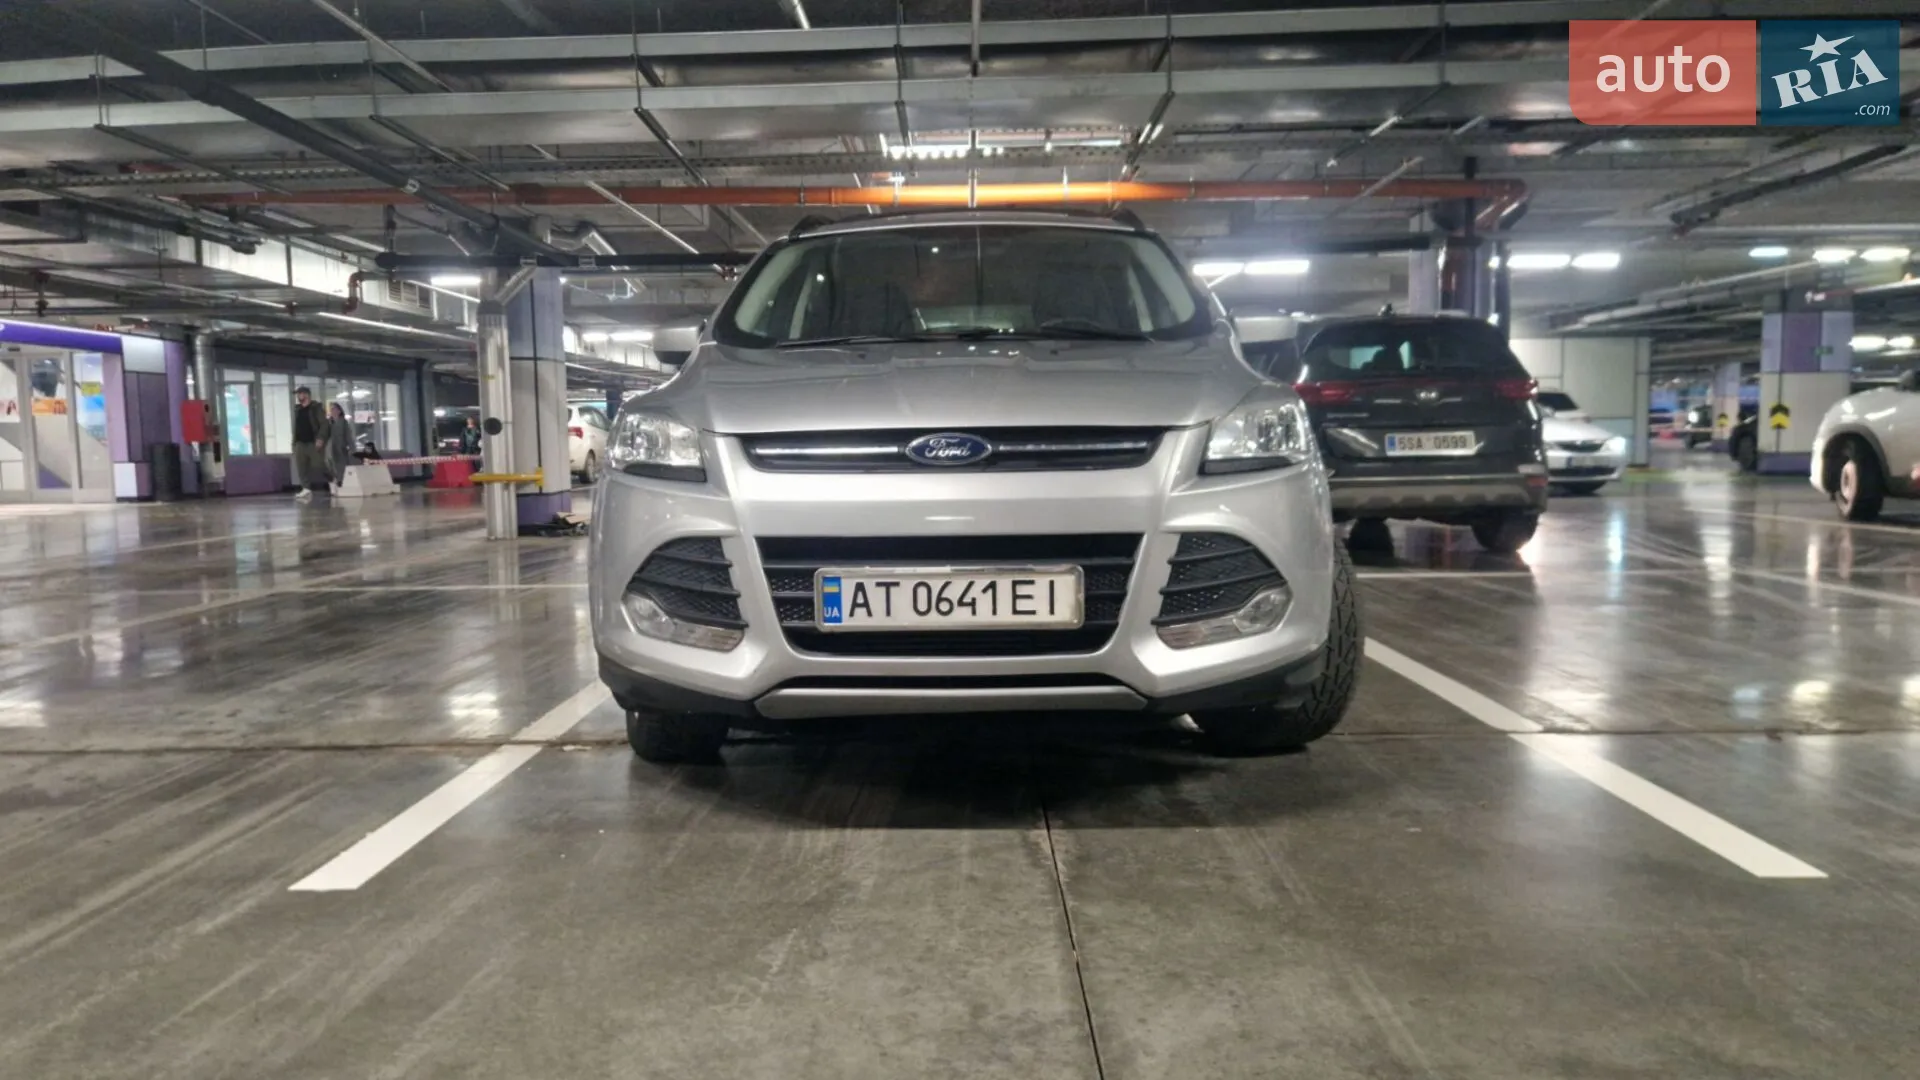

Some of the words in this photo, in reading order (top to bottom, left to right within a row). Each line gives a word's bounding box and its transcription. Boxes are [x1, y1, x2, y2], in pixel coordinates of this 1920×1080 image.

[925, 437, 972, 458] Ford
[849, 582, 900, 617] AT
[912, 580, 997, 617] 0641
[1011, 579, 1055, 616] EI
[823, 606, 840, 618] UA
